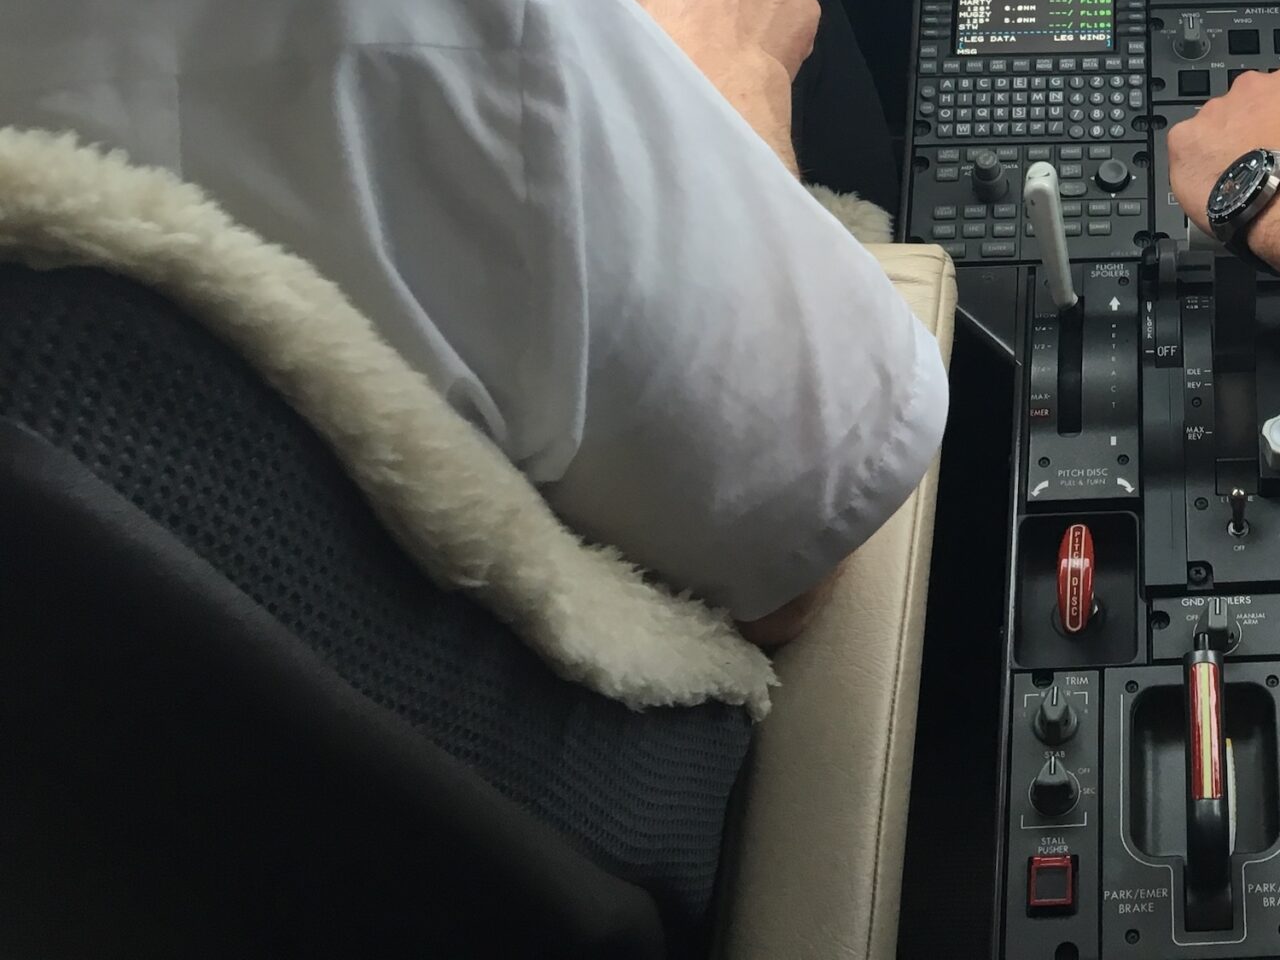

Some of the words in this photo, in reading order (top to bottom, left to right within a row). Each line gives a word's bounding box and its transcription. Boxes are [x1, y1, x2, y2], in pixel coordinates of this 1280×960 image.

[1244, 7, 1279, 15] ANTI-ICE
[990, 34, 1017, 42] DATA
[1095, 263, 1124, 273] FLIGHT
[1091, 269, 1130, 279] SPOILERS
[1157, 345, 1177, 357] OFF
[1186, 367, 1202, 376] IDLE
[1187, 381, 1201, 389] REV
[1030, 408, 1049, 417] EMER
[1185, 425, 1205, 435] MAX
[1187, 432, 1202, 441] REV
[1057, 468, 1085, 478] PITCH
[1086, 467, 1109, 477] DISC
[1060, 479, 1076, 487] PULL
[1088, 477, 1107, 486] TURN
[1072, 531, 1081, 568] PITCH
[1181, 598, 1205, 606] GND
[1207, 596, 1252, 605] ILERS
[1186, 614, 1199, 622] OFF
[1065, 677, 1089, 685] TRIM
[1040, 837, 1066, 846] STALL
[1037, 844, 1069, 854] PUSHER
[1103, 886, 1168, 900] PARK/EMER
[1118, 902, 1154, 914] BRAKE
